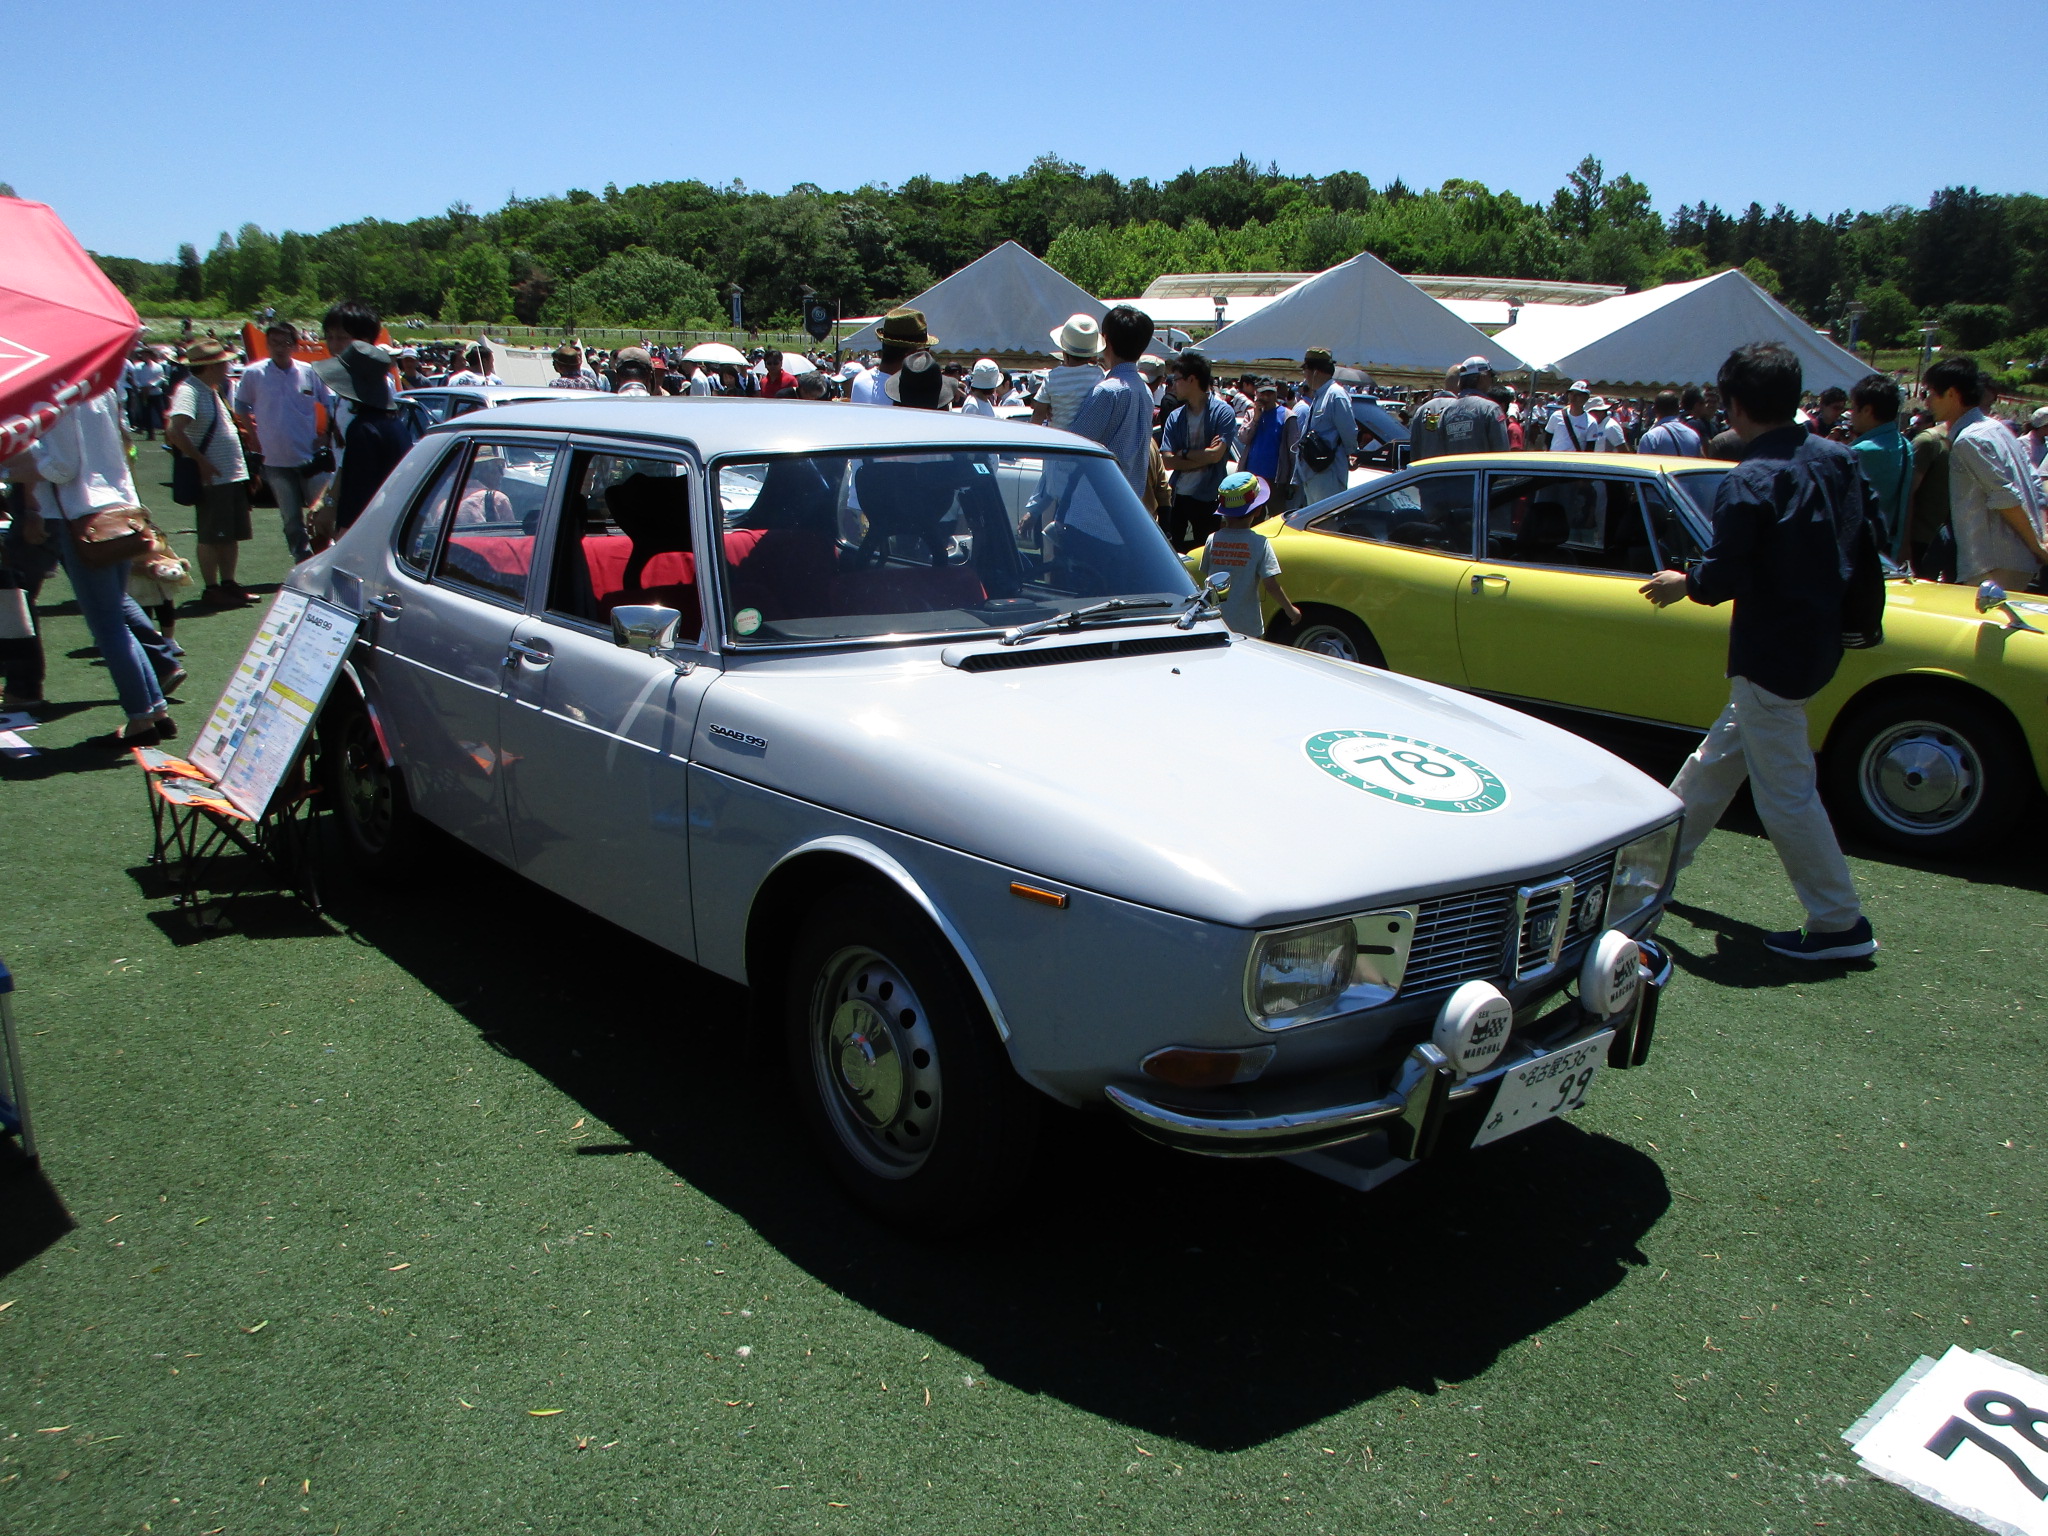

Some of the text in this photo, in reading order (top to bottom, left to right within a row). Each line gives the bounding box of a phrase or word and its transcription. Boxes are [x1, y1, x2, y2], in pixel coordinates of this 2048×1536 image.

[305, 613, 333, 631] SAAB 99
[709, 724, 766, 748] SAAB 99
[1309, 730, 1502, 813] CLASSIC CAR FESTIVAL 2017
[1354, 749, 1456, 786] 78
[1610, 979, 1635, 1003] MARCHAL
[1477, 1010, 1490, 1019] SEV
[1462, 1042, 1501, 1060] MARCHAL
[1923, 1389, 2048, 1502] 78
